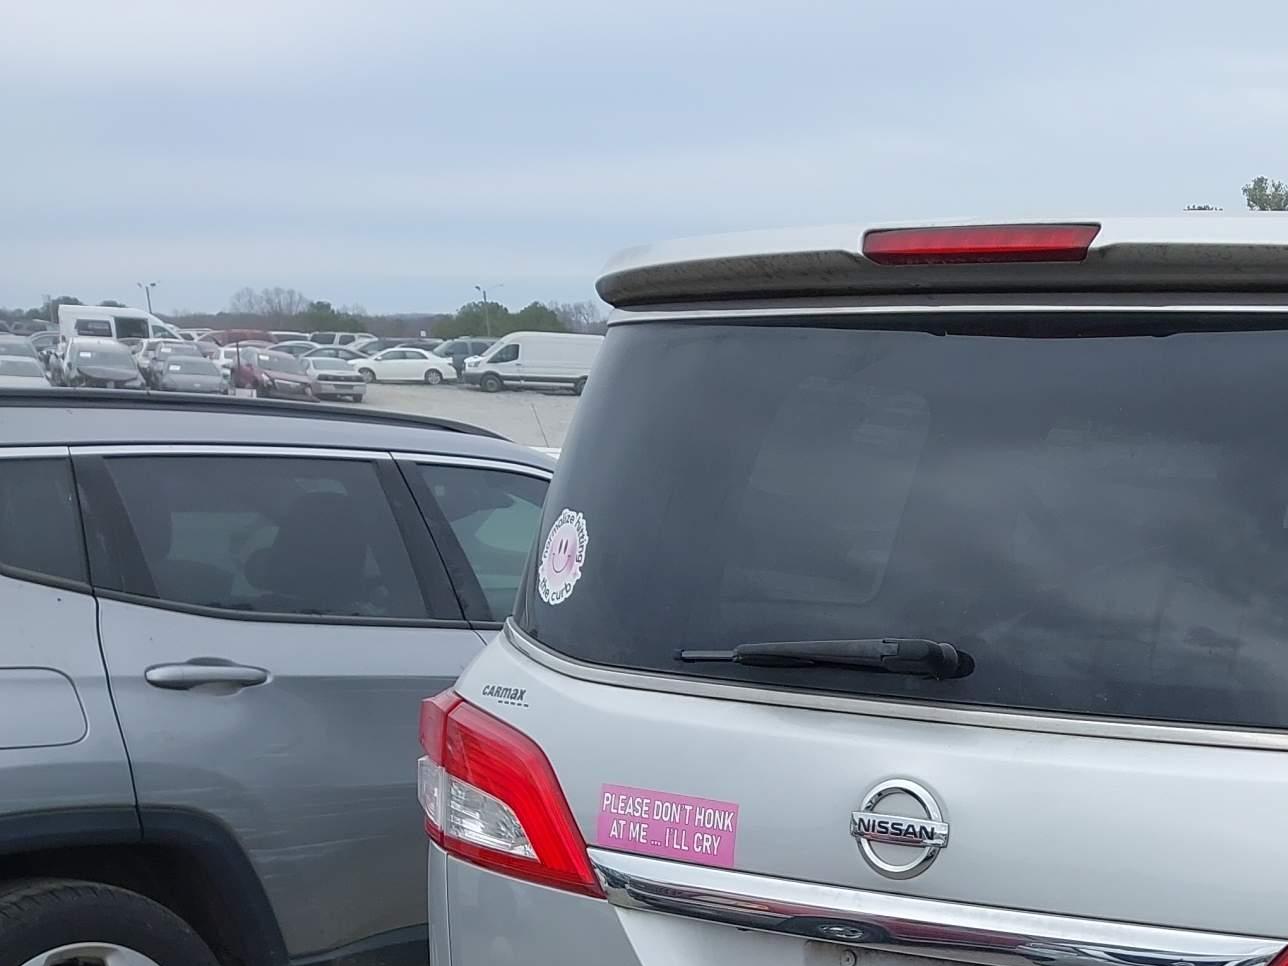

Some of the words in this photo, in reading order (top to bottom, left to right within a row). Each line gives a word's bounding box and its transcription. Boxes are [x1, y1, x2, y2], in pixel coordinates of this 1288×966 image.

[540, 577, 550, 599] the
[550, 582, 571, 602] curb
[602, 792, 651, 819] PLEASE
[653, 800, 693, 826] DON'T
[694, 806, 734, 833] HONK
[609, 819, 627, 839] AT
[628, 822, 649, 844] ME
[665, 827, 689, 851] I'LL
[693, 832, 721, 856] CRY
[857, 817, 935, 841] NISSAN
